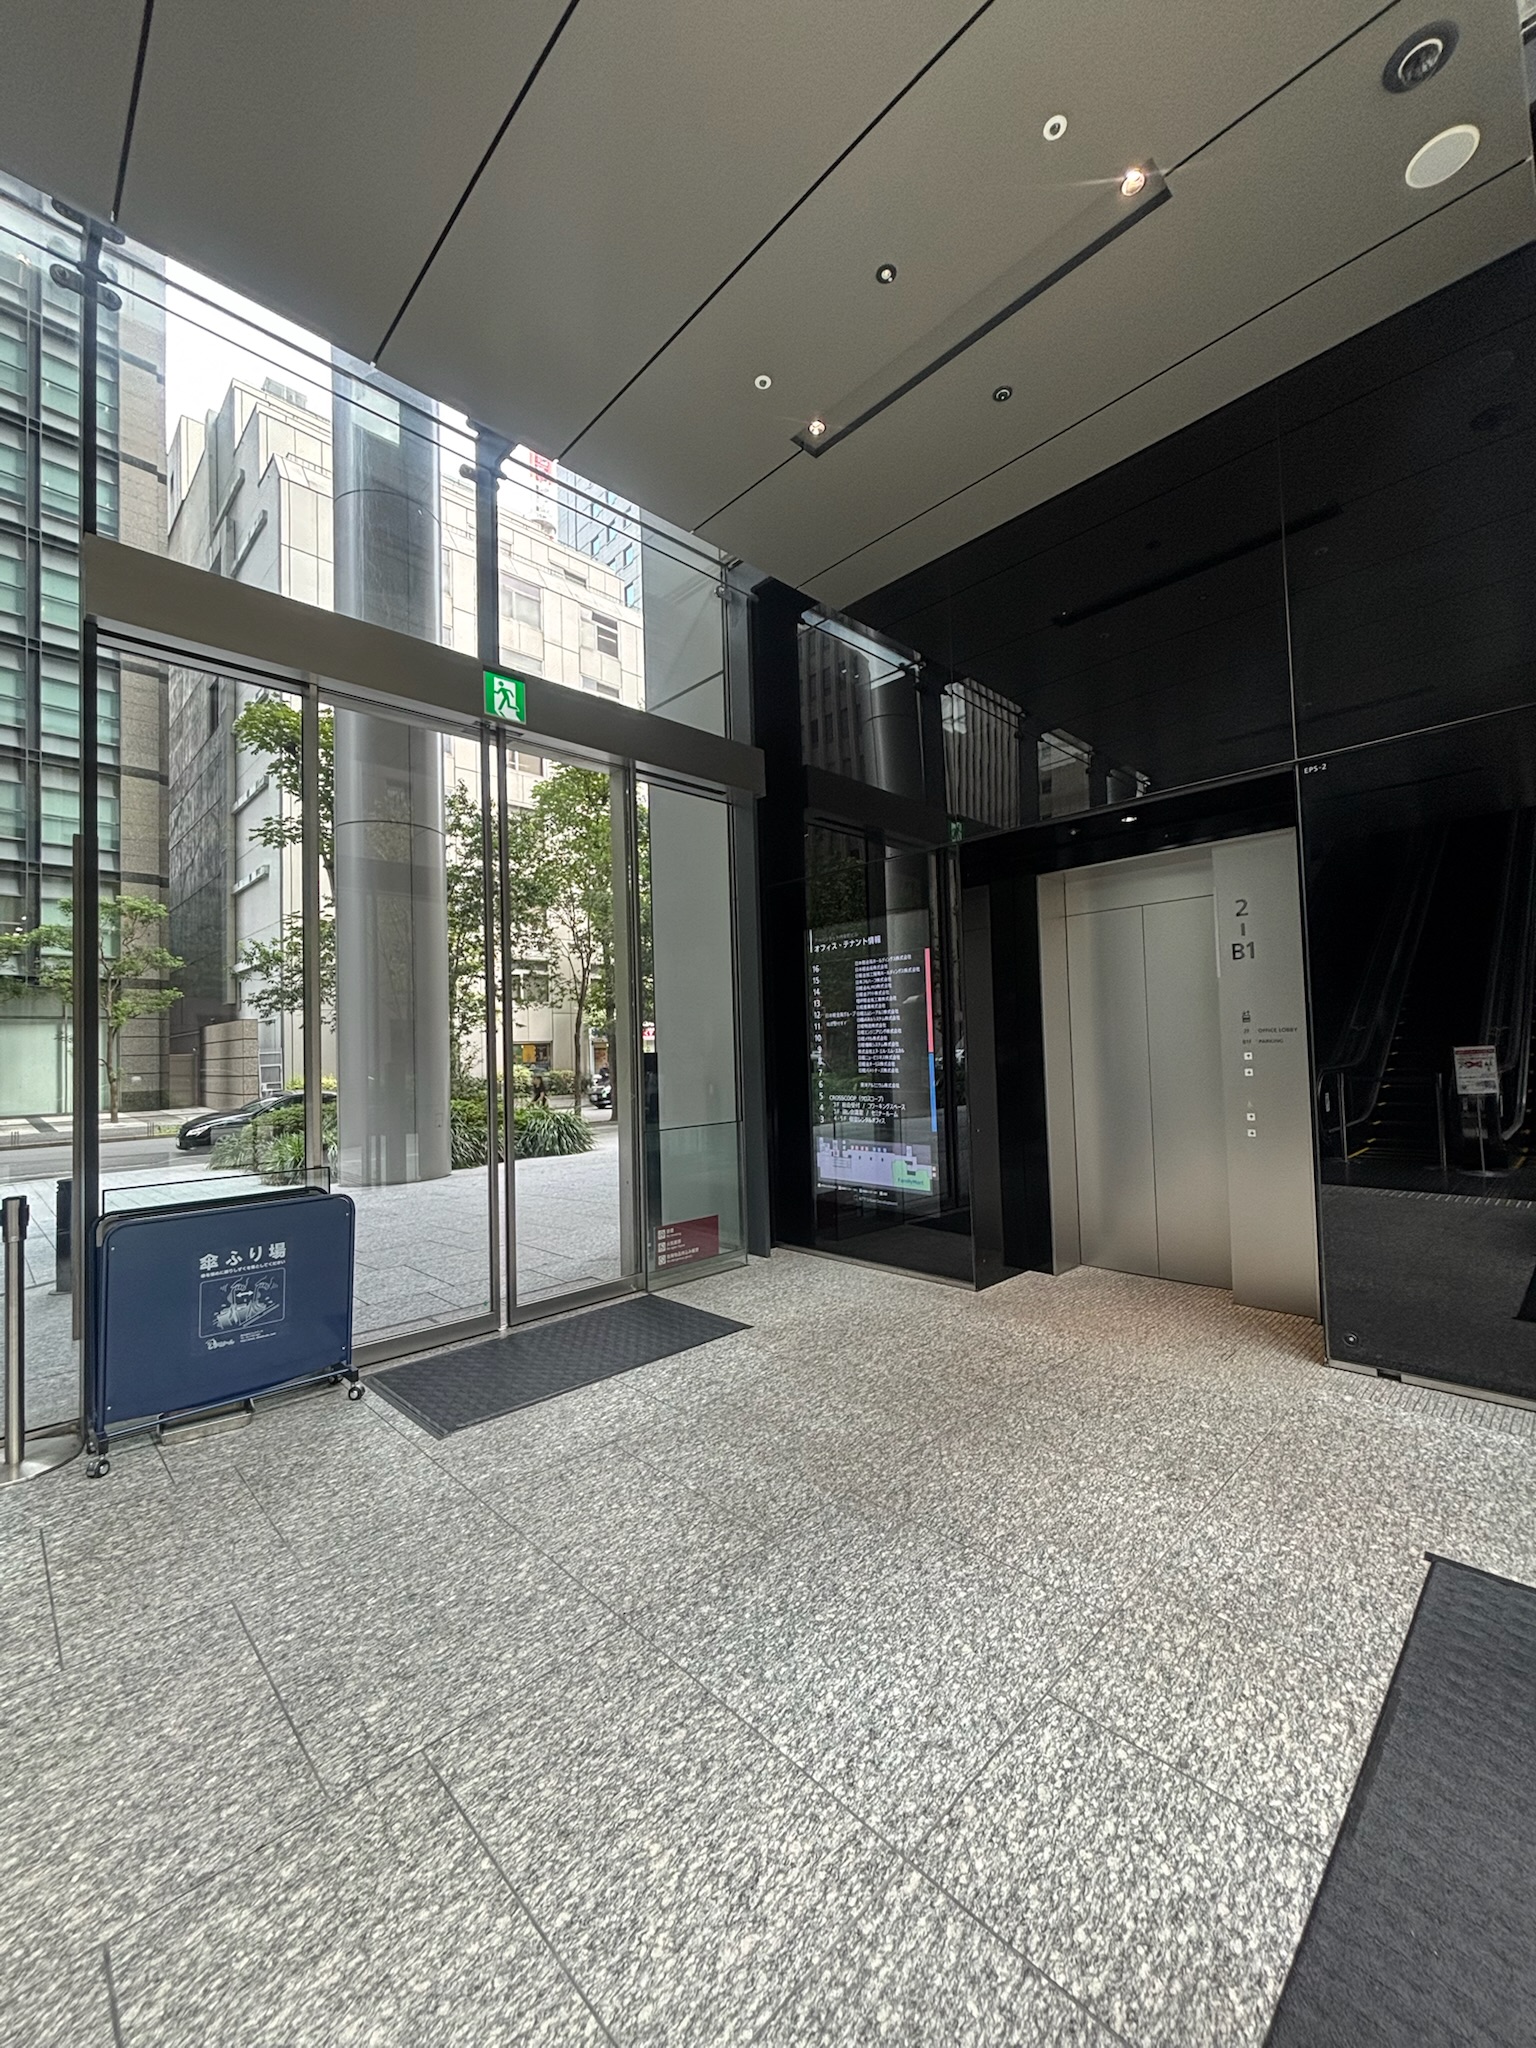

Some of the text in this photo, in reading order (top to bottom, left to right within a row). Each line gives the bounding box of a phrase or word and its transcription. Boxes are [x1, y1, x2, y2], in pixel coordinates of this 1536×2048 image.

[1303, 763, 1327, 774] EPS-2
[1235, 899, 1249, 917] 2
[814, 935, 882, 953] オフィス・テナント情報
[1232, 941, 1255, 960] B1
[812, 965, 820, 973] 16
[812, 976, 820, 985] 15
[813, 988, 820, 996] 14
[813, 1000, 821, 1008] 13
[814, 1011, 821, 1019] 12
[814, 1022, 821, 1031] 11
[815, 1034, 822, 1042] 10
[818, 1069, 823, 1077] 7
[818, 1080, 824, 1089] 6
[819, 1092, 824, 1100] 5
[819, 1103, 825, 1112] 4
[820, 1115, 825, 1124] 3
[199, 1242, 286, 1271] 傘ふり場
